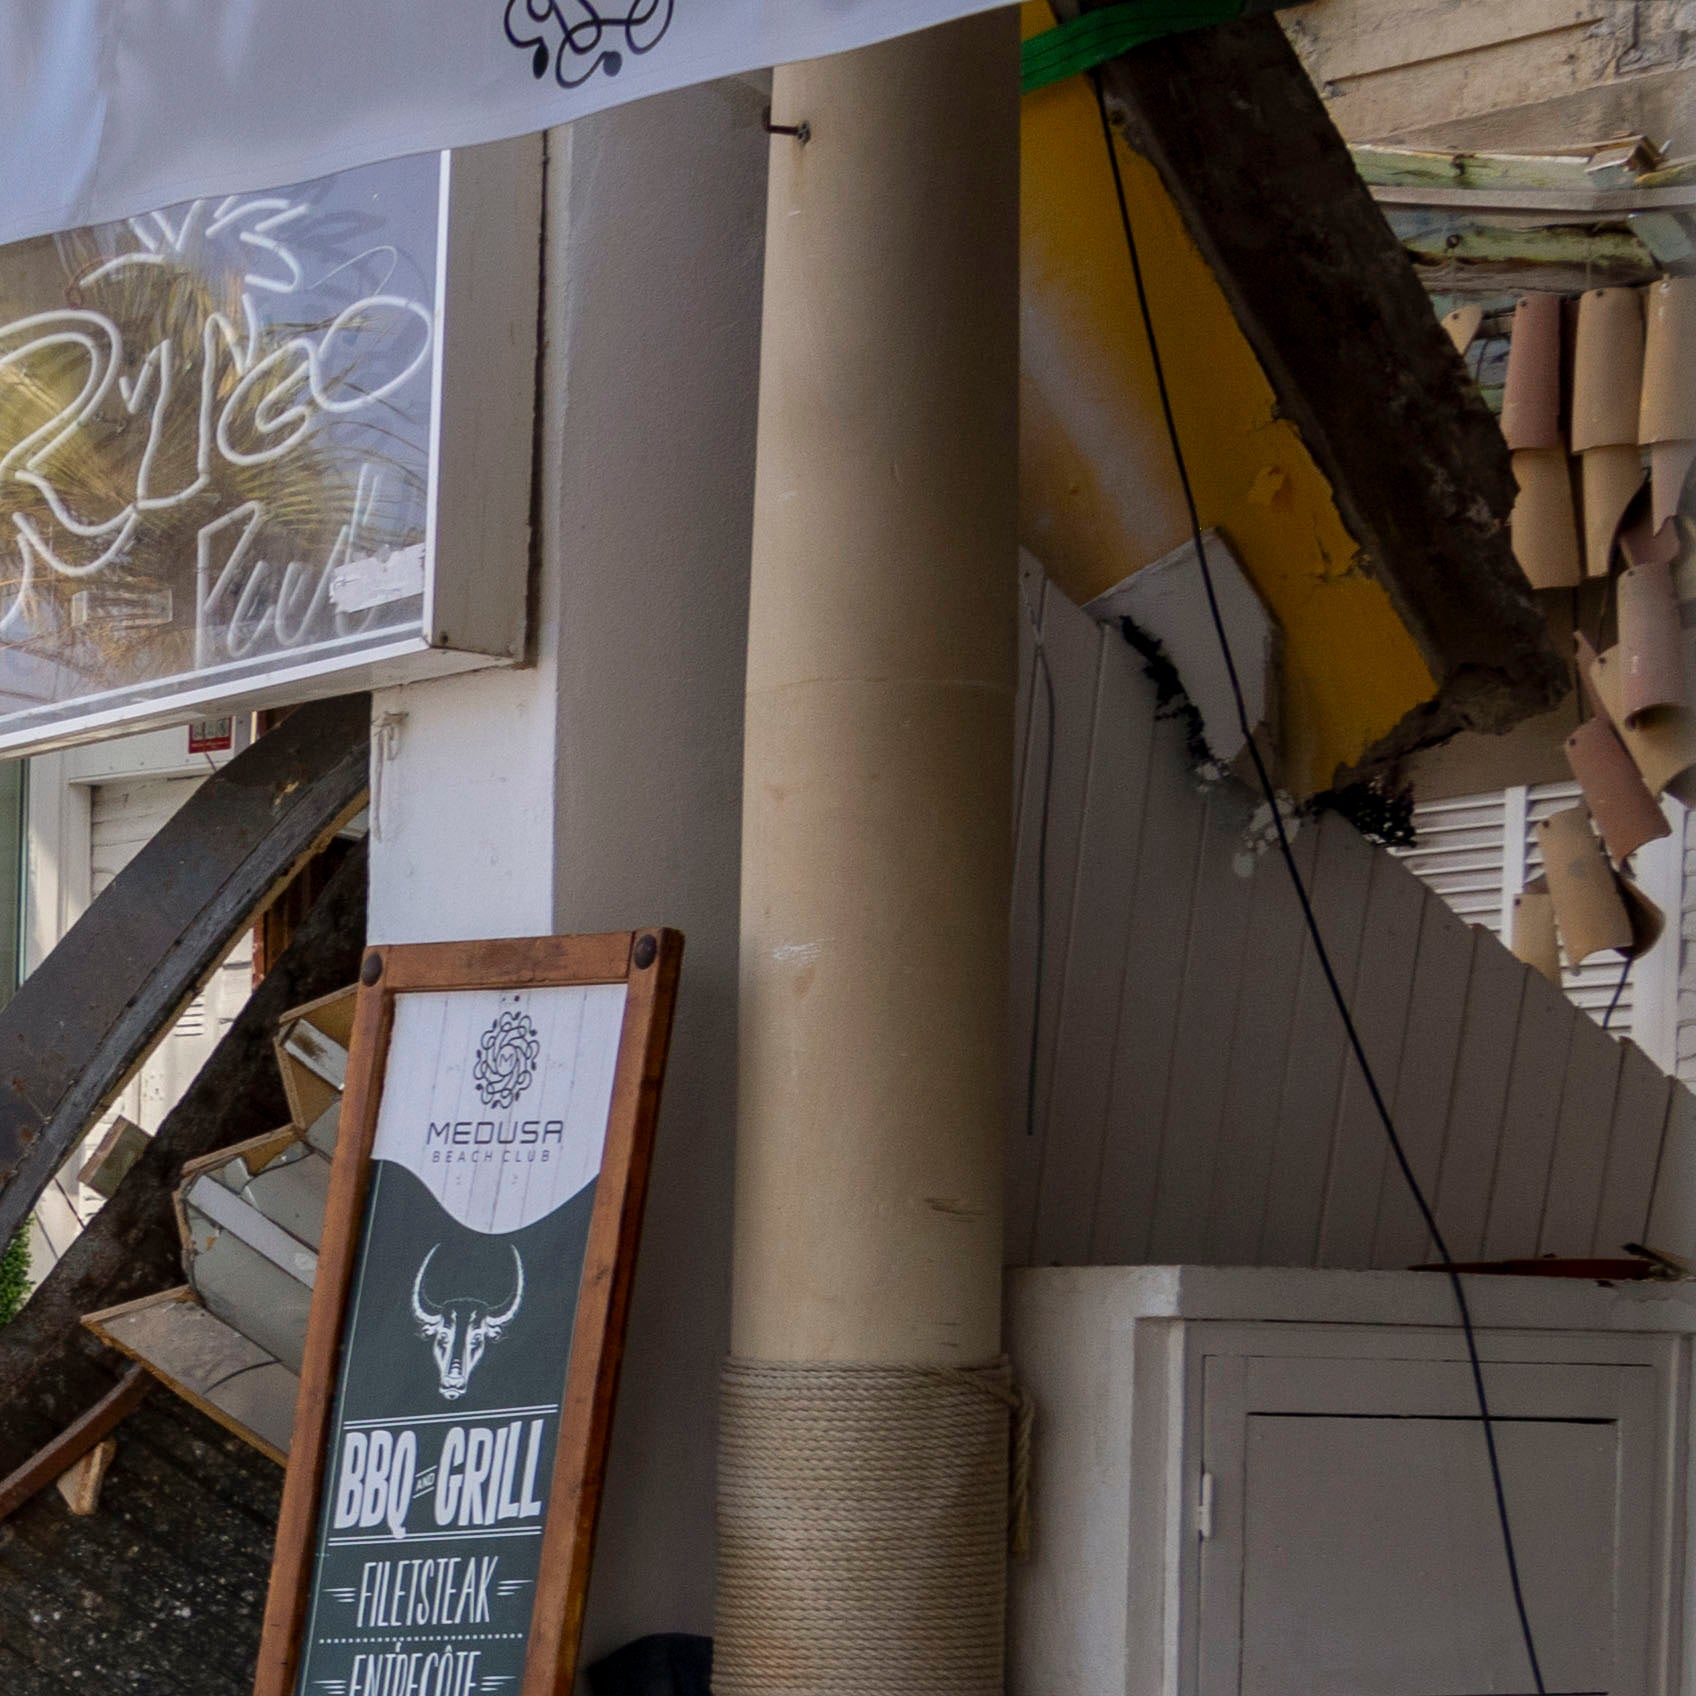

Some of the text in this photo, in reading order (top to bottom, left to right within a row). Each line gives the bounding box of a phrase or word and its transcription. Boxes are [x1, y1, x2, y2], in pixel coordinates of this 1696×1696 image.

[426, 1119, 564, 1146] MEDUSA
[431, 1149, 551, 1164] BEACH CLUB
[333, 1429, 418, 1539] BBQ
[434, 1419, 545, 1527] GRILL
[356, 1556, 498, 1628] FILETSTEAK
